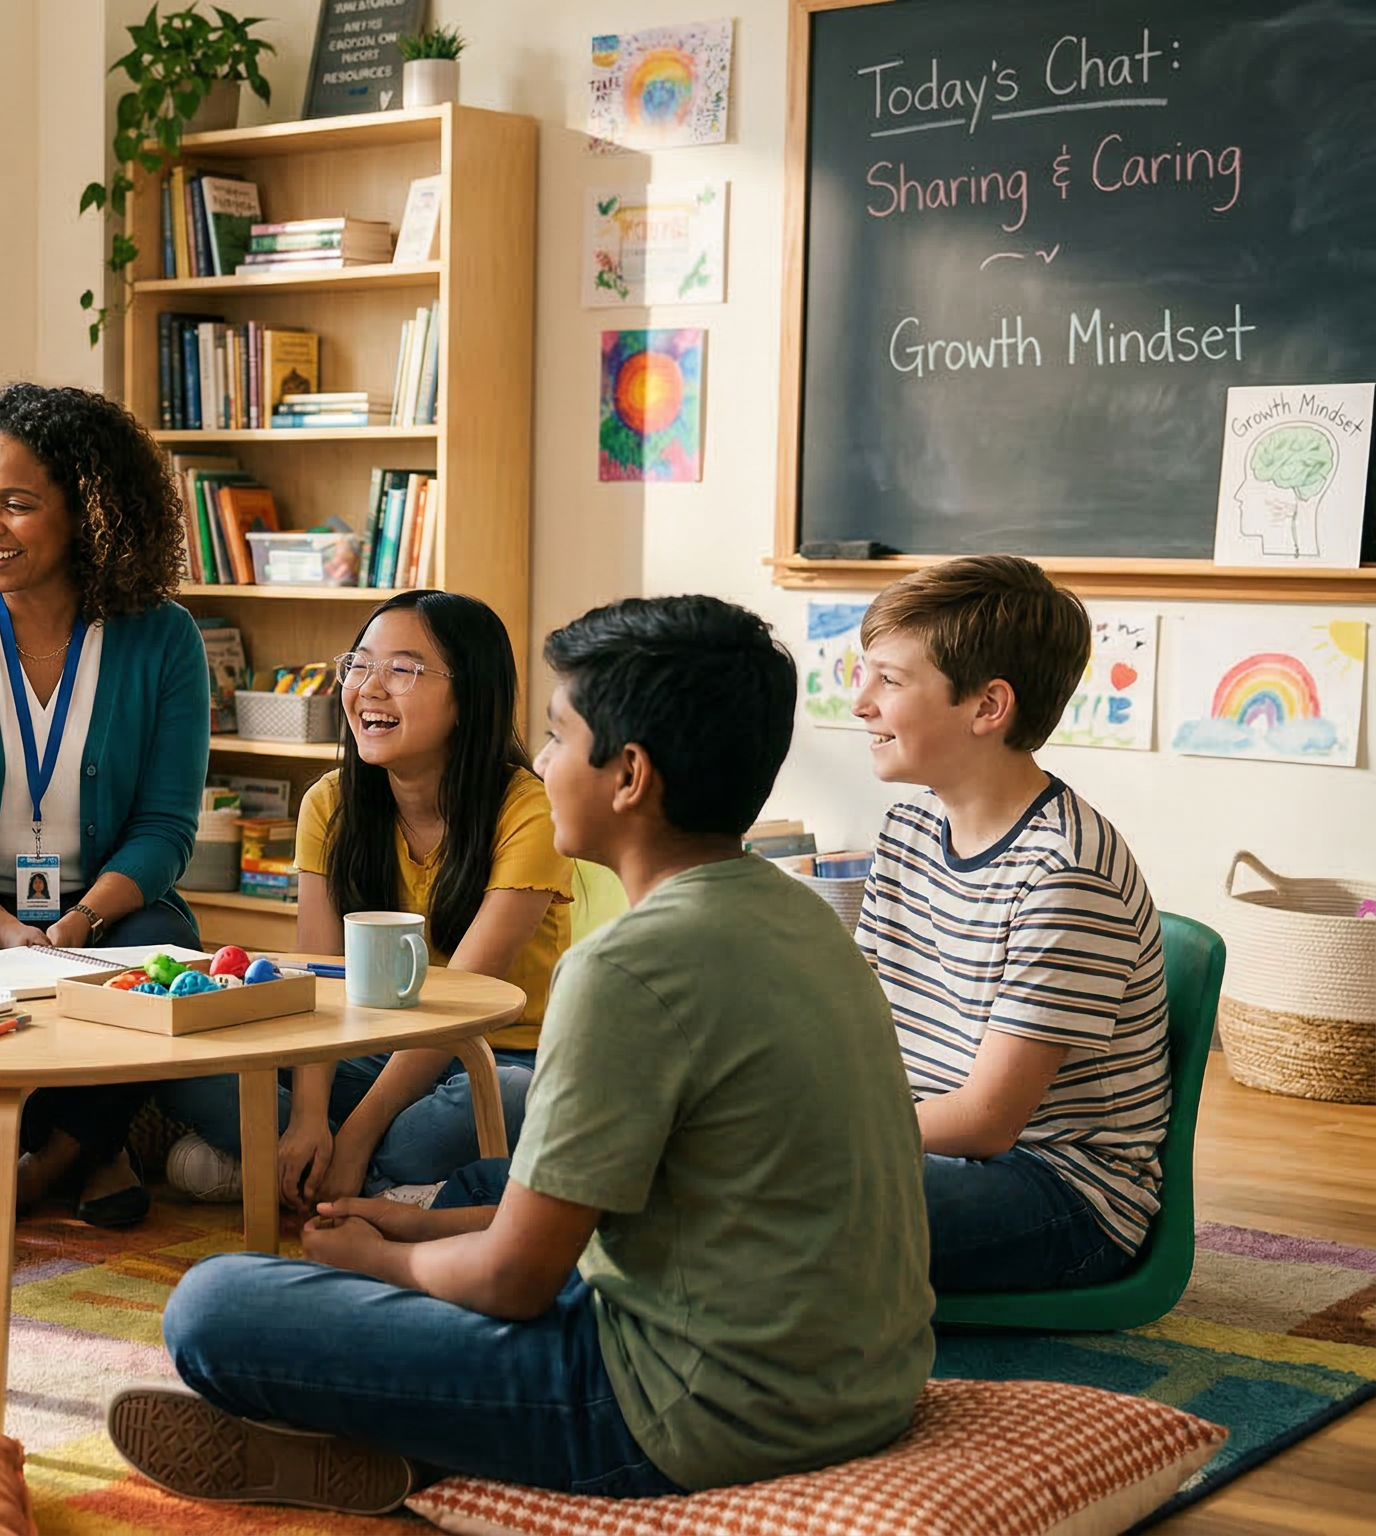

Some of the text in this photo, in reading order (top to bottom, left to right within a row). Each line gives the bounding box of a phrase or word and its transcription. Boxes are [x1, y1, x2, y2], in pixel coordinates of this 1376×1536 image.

[857, 28, 1181, 134] Today's Chat:
[866, 133, 1243, 232] Sharing & Caring
[889, 302, 1257, 378] Growth Mindset
[1231, 392, 1365, 438] Growth Mindset
